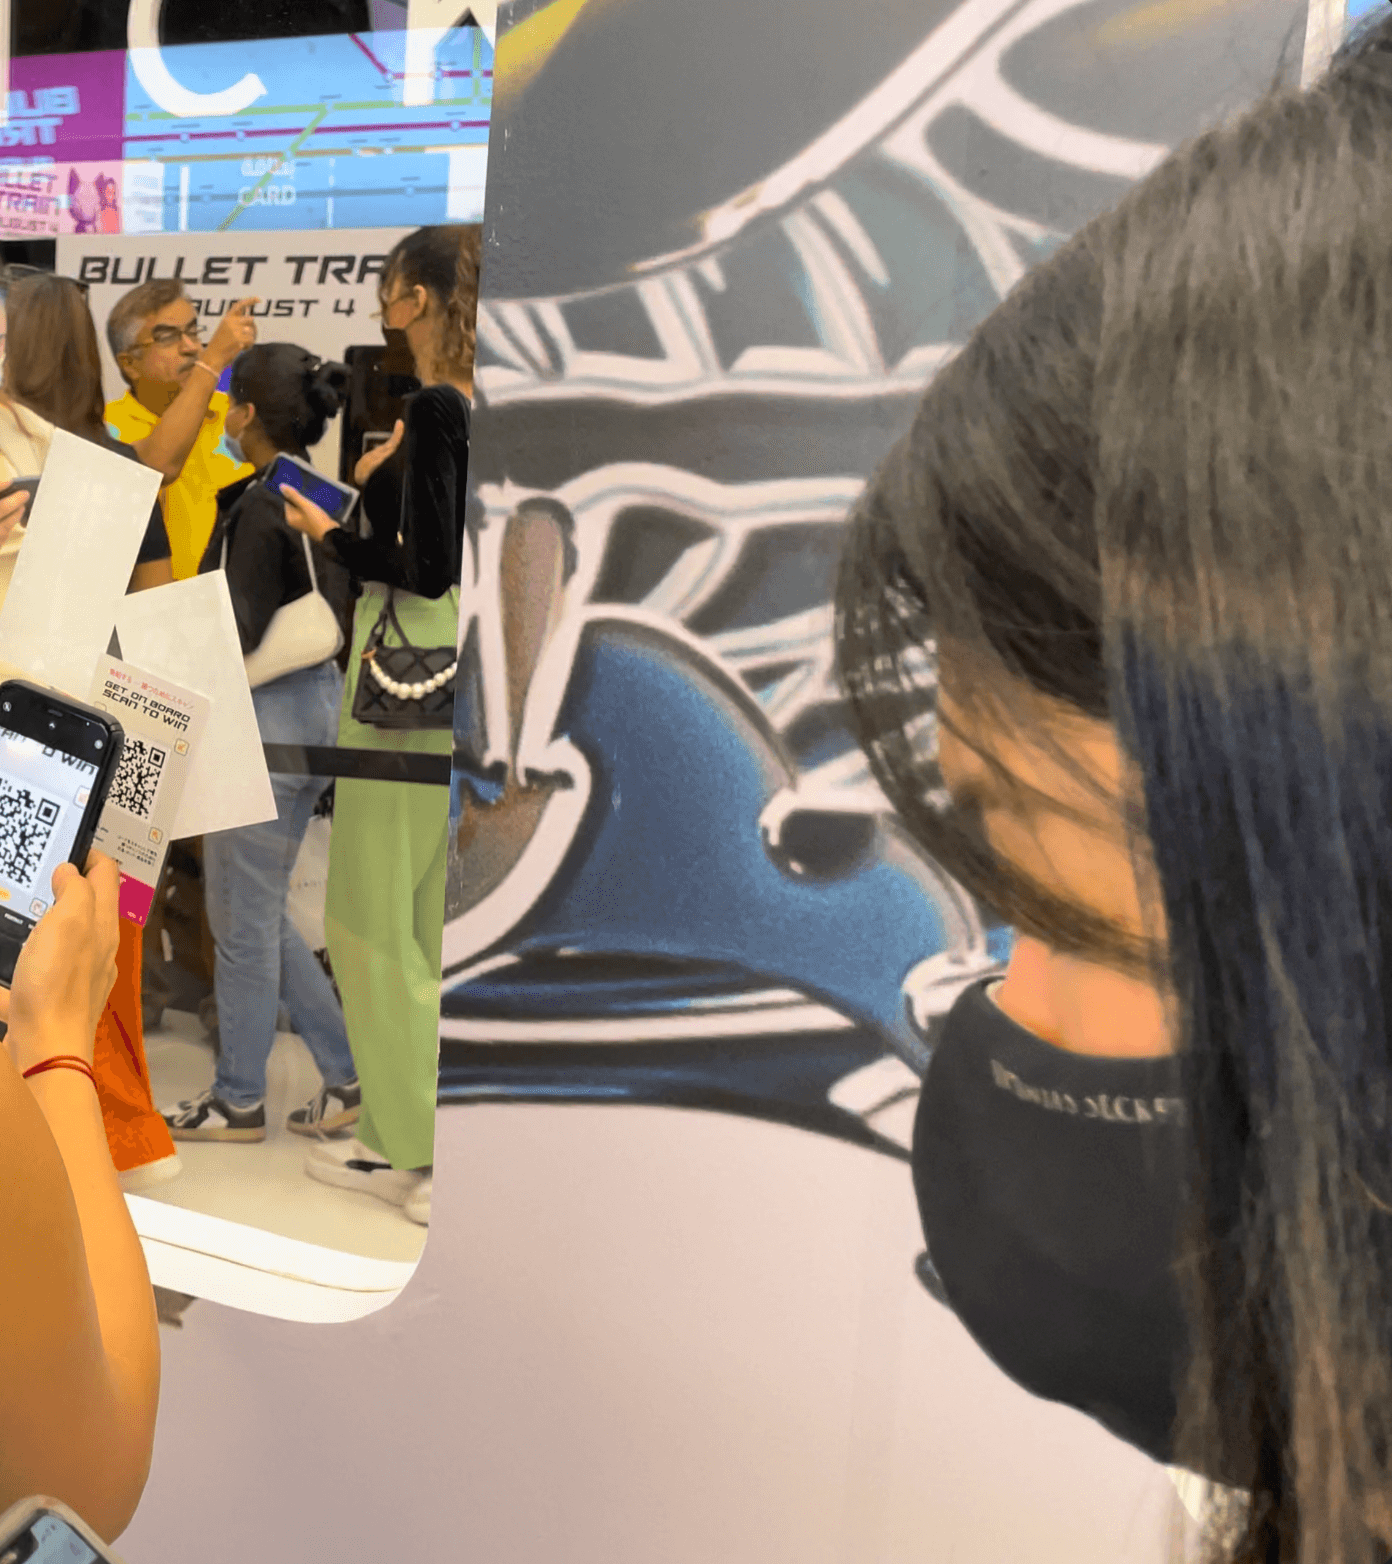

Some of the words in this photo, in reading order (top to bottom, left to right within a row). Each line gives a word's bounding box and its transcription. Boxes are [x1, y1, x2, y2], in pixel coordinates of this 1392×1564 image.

[237, 185, 296, 207] CARD
[79, 256, 268, 285] BULLET
[285, 255, 390, 284] TRA
[333, 299, 355, 317] 4
[102, 688, 139, 710] SCAN
[142, 705, 160, 719] TO
[163, 715, 188, 732] WIN
[105, 680, 128, 694] GET
[130, 692, 148, 704] ON
[149, 700, 191, 723] BOARD
[61, 752, 96, 776] WIN
